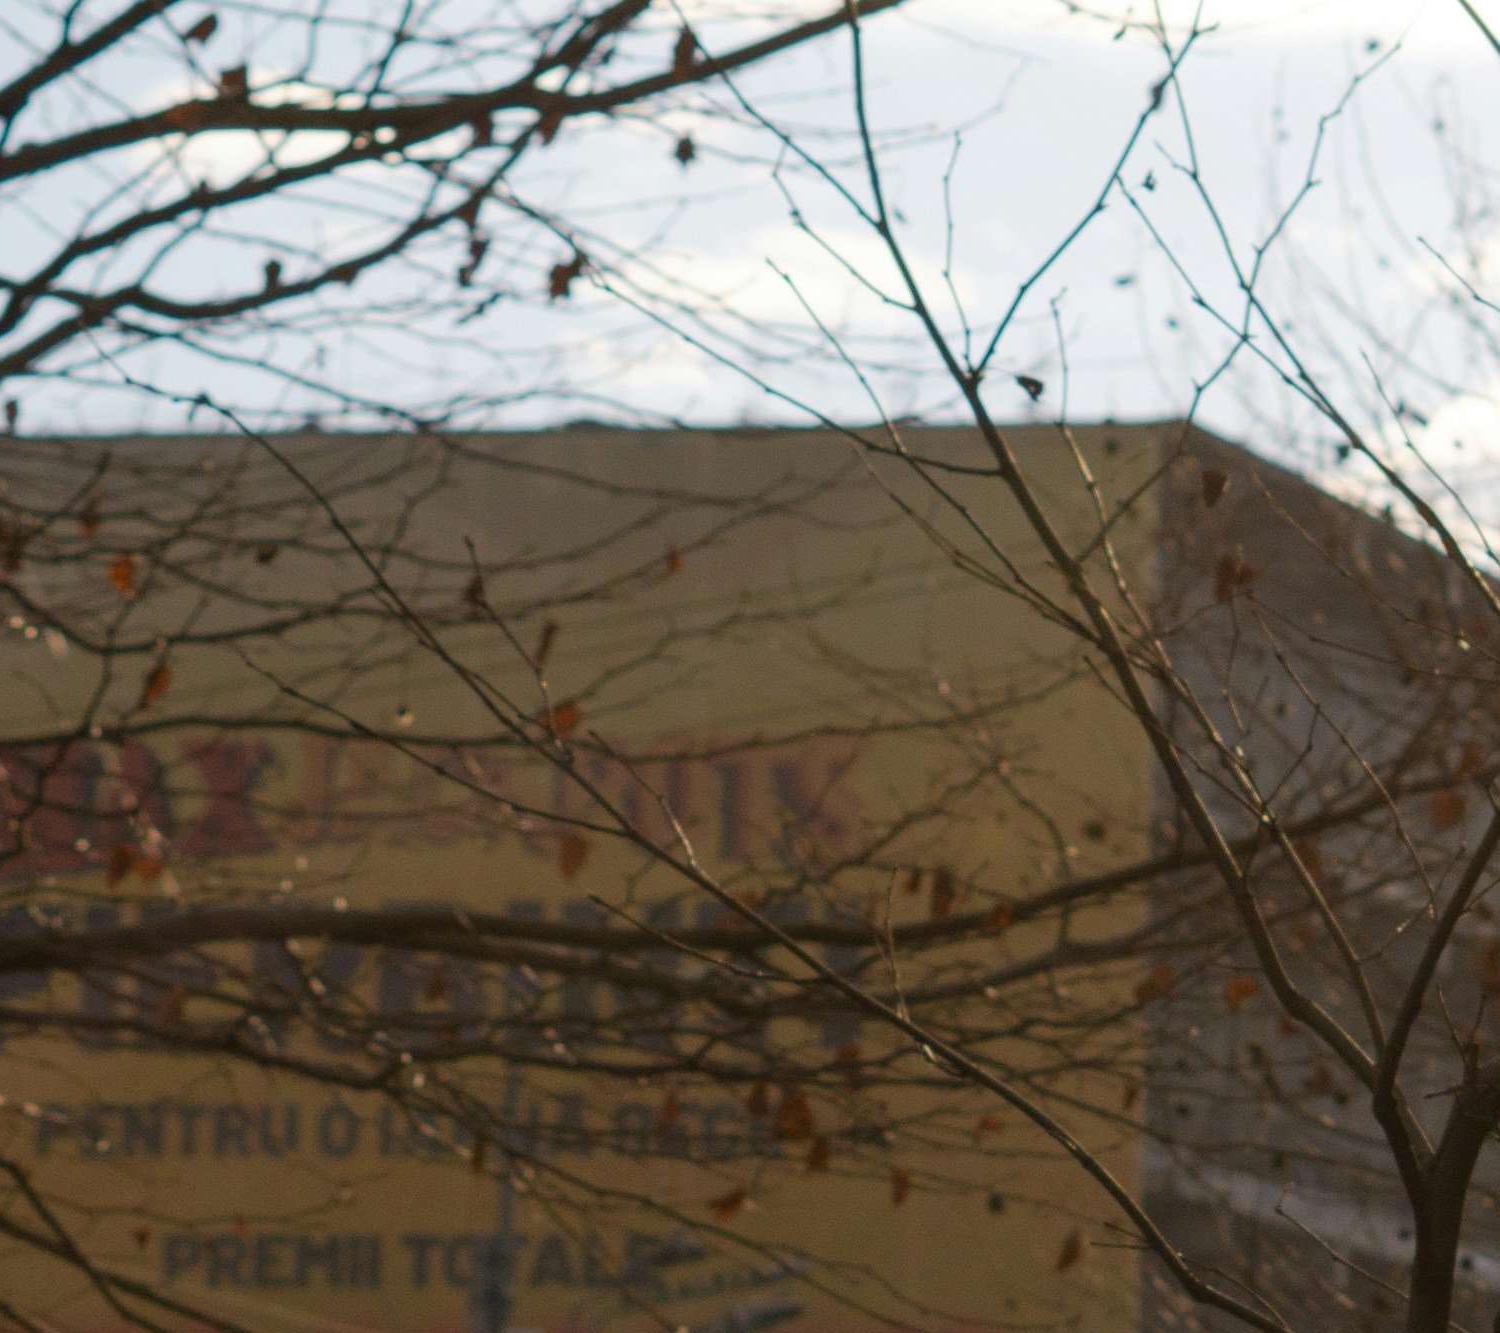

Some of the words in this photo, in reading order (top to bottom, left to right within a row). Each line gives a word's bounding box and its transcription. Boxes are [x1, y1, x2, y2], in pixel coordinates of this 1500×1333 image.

[32, 1097, 299, 1160] PENTRU
[318, 1099, 361, 1159] O
[161, 1233, 384, 1291] PREMII
